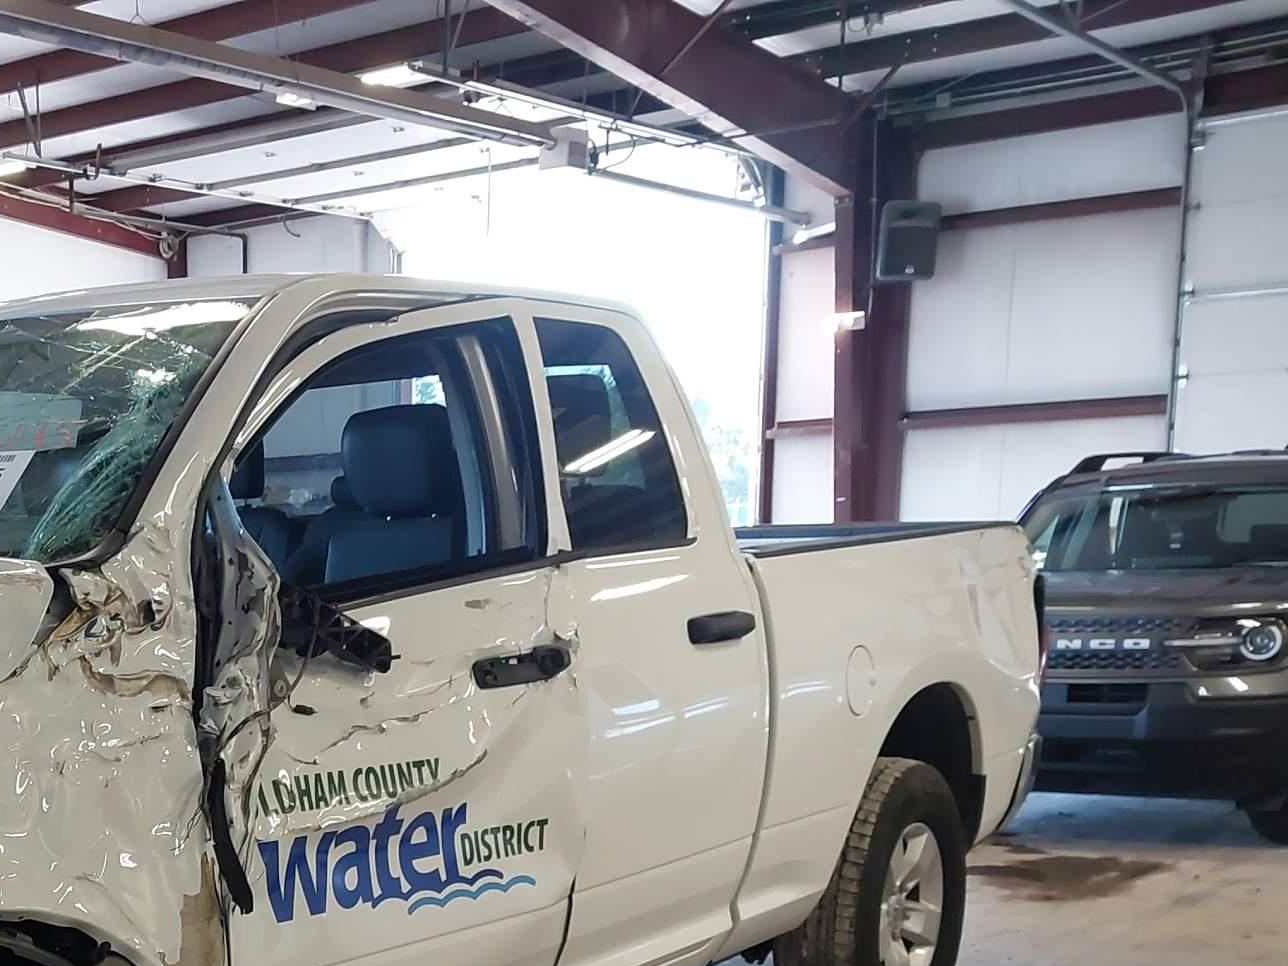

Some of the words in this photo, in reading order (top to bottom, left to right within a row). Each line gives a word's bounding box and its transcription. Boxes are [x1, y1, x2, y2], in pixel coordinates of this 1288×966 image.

[1056, 638, 1151, 650] NCO
[258, 769, 352, 817] LDHAM
[352, 757, 440, 803] COUNTY
[461, 818, 549, 867] DISTRICT
